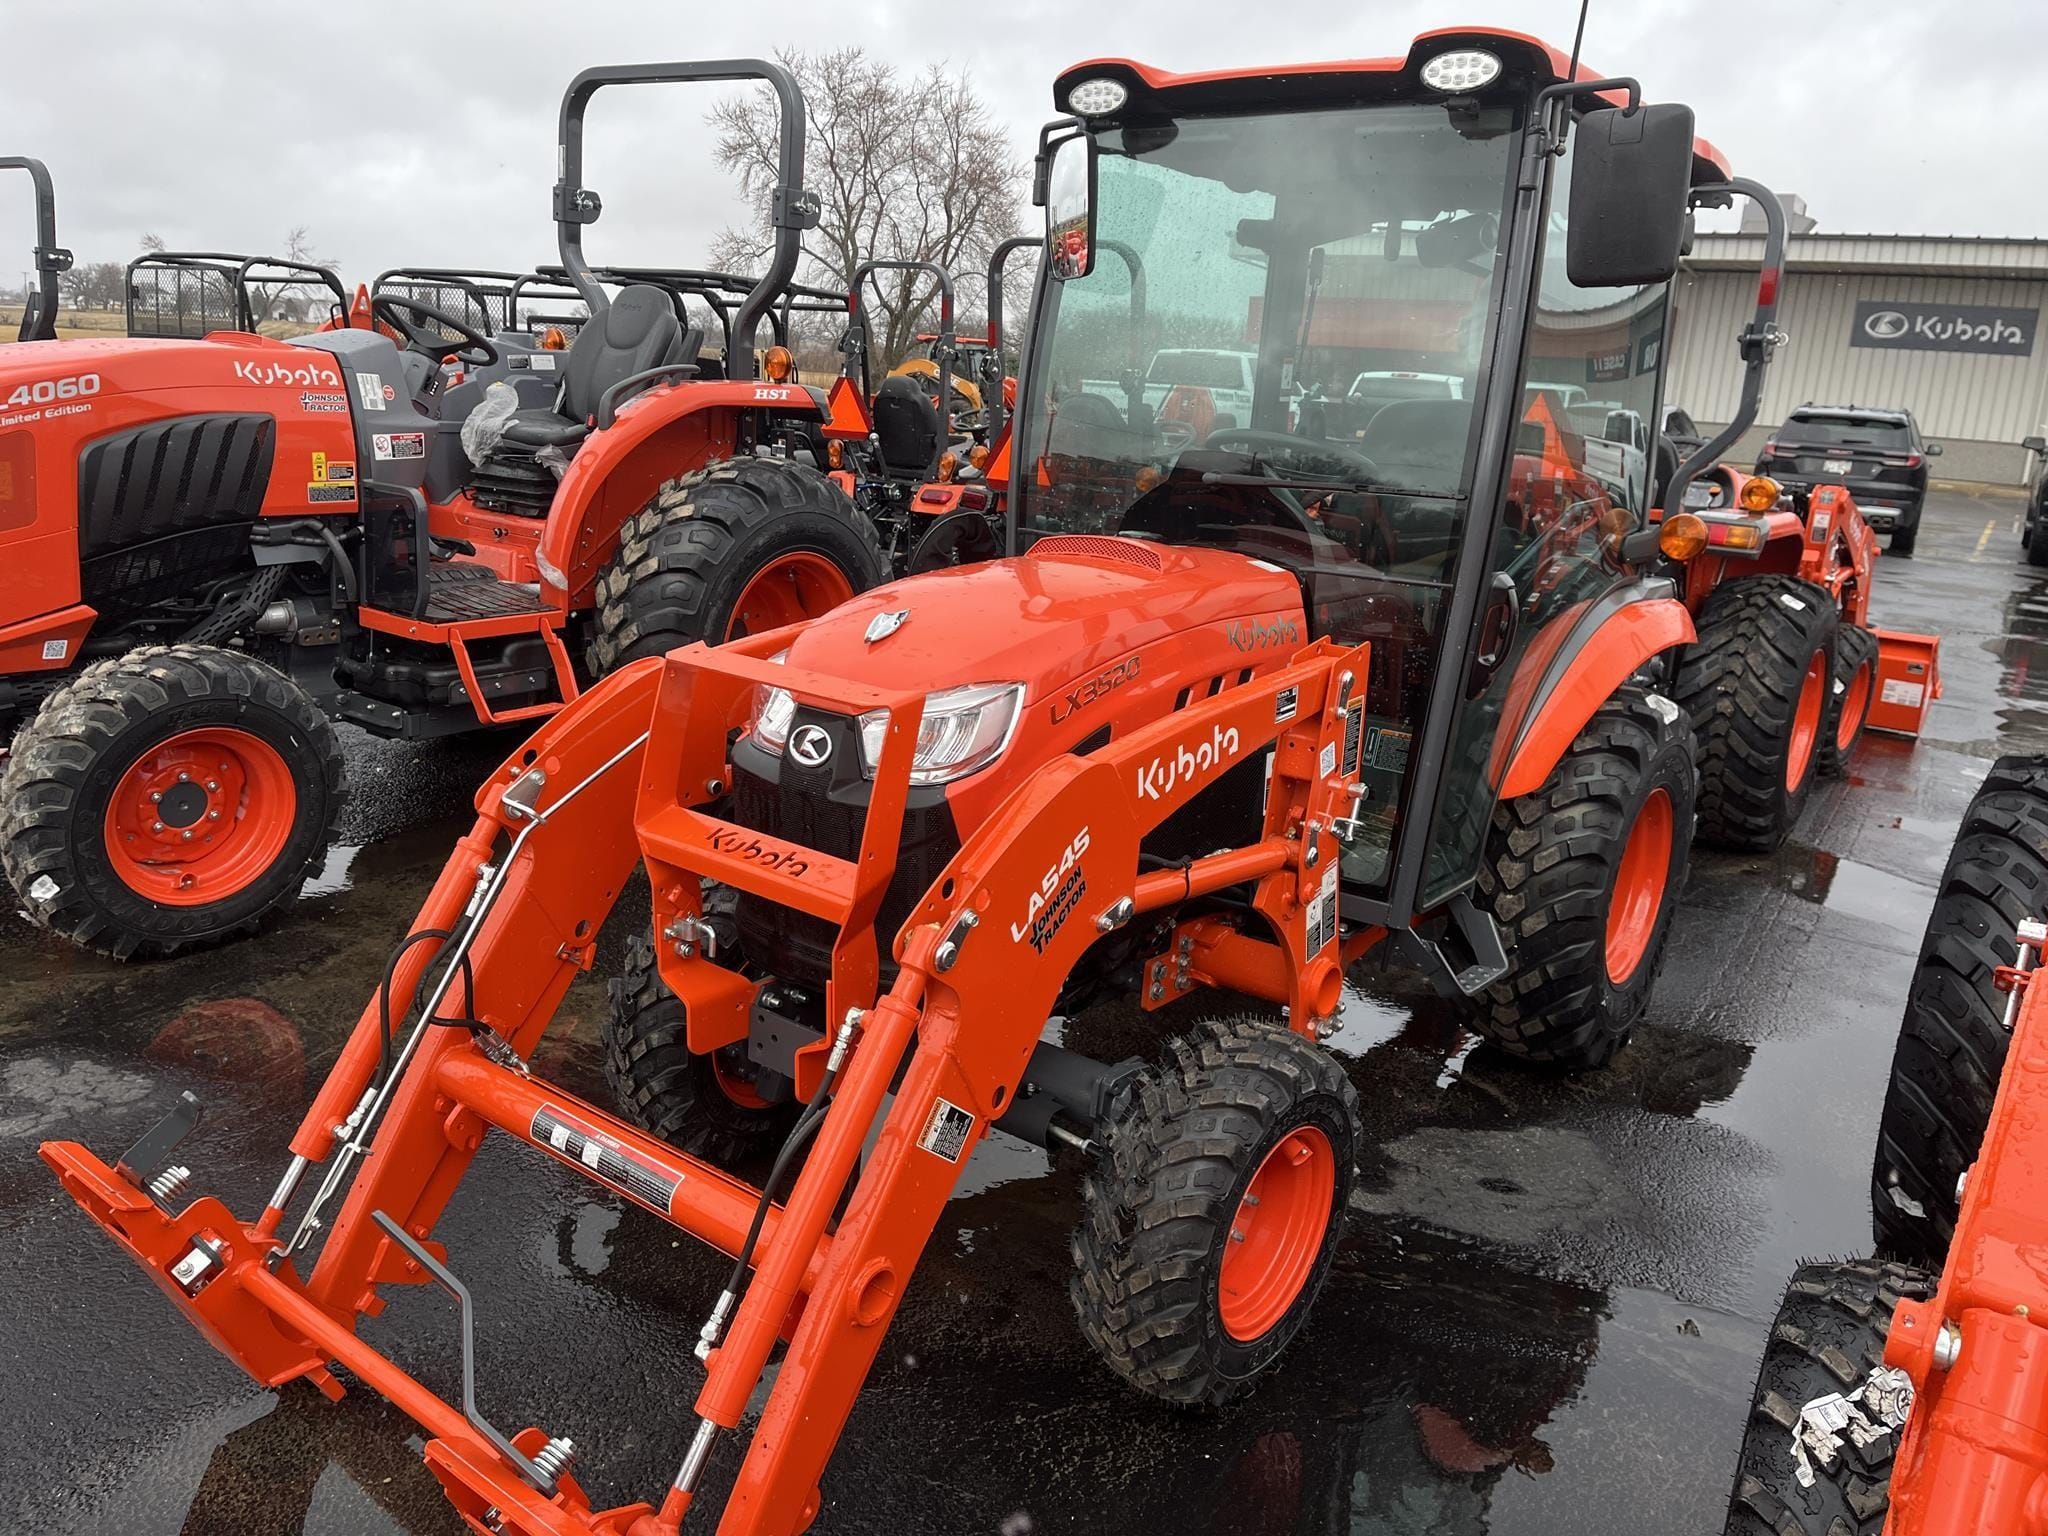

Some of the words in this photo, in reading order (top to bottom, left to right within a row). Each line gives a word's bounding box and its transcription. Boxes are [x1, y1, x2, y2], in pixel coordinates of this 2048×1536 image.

[1914, 315, 2022, 344] Kubota
[0, 373, 101, 411] 4060
[233, 360, 339, 386] Kubota
[300, 391, 345, 402] JOHNSON
[302, 401, 346, 412] TRACTOR
[753, 388, 791, 400] HST
[0, 411, 40, 427] imited
[44, 403, 92, 418] Edition
[1225, 613, 1298, 653] Kubota
[1050, 656, 1140, 726] LX3520
[1137, 724, 1239, 801] Kubota
[705, 827, 809, 877] Kubota
[1010, 825, 1090, 943] LA545
[1029, 865, 1082, 946] JOHNSON
[1033, 880, 1087, 955] TRACTOR
[599, 1134, 621, 1150] DANGER
